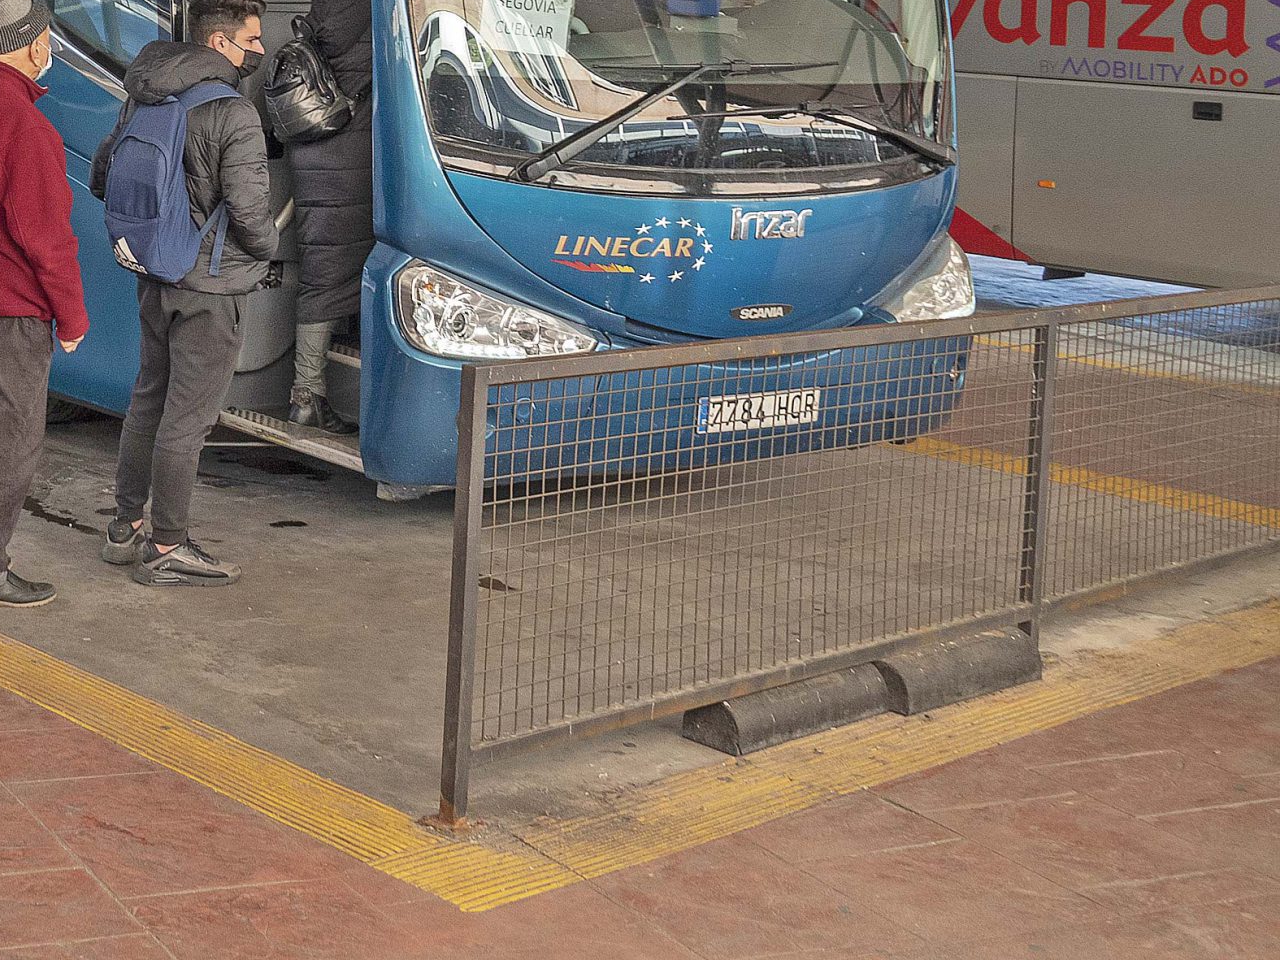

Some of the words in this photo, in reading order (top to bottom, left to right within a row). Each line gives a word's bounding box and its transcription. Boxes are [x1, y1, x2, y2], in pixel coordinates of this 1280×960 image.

[1061, 57, 1185, 82] MOBILITY
[1189, 64, 1249, 87] ADO
[553, 235, 695, 258] LINECAR
[738, 305, 785, 320] SCANIA
